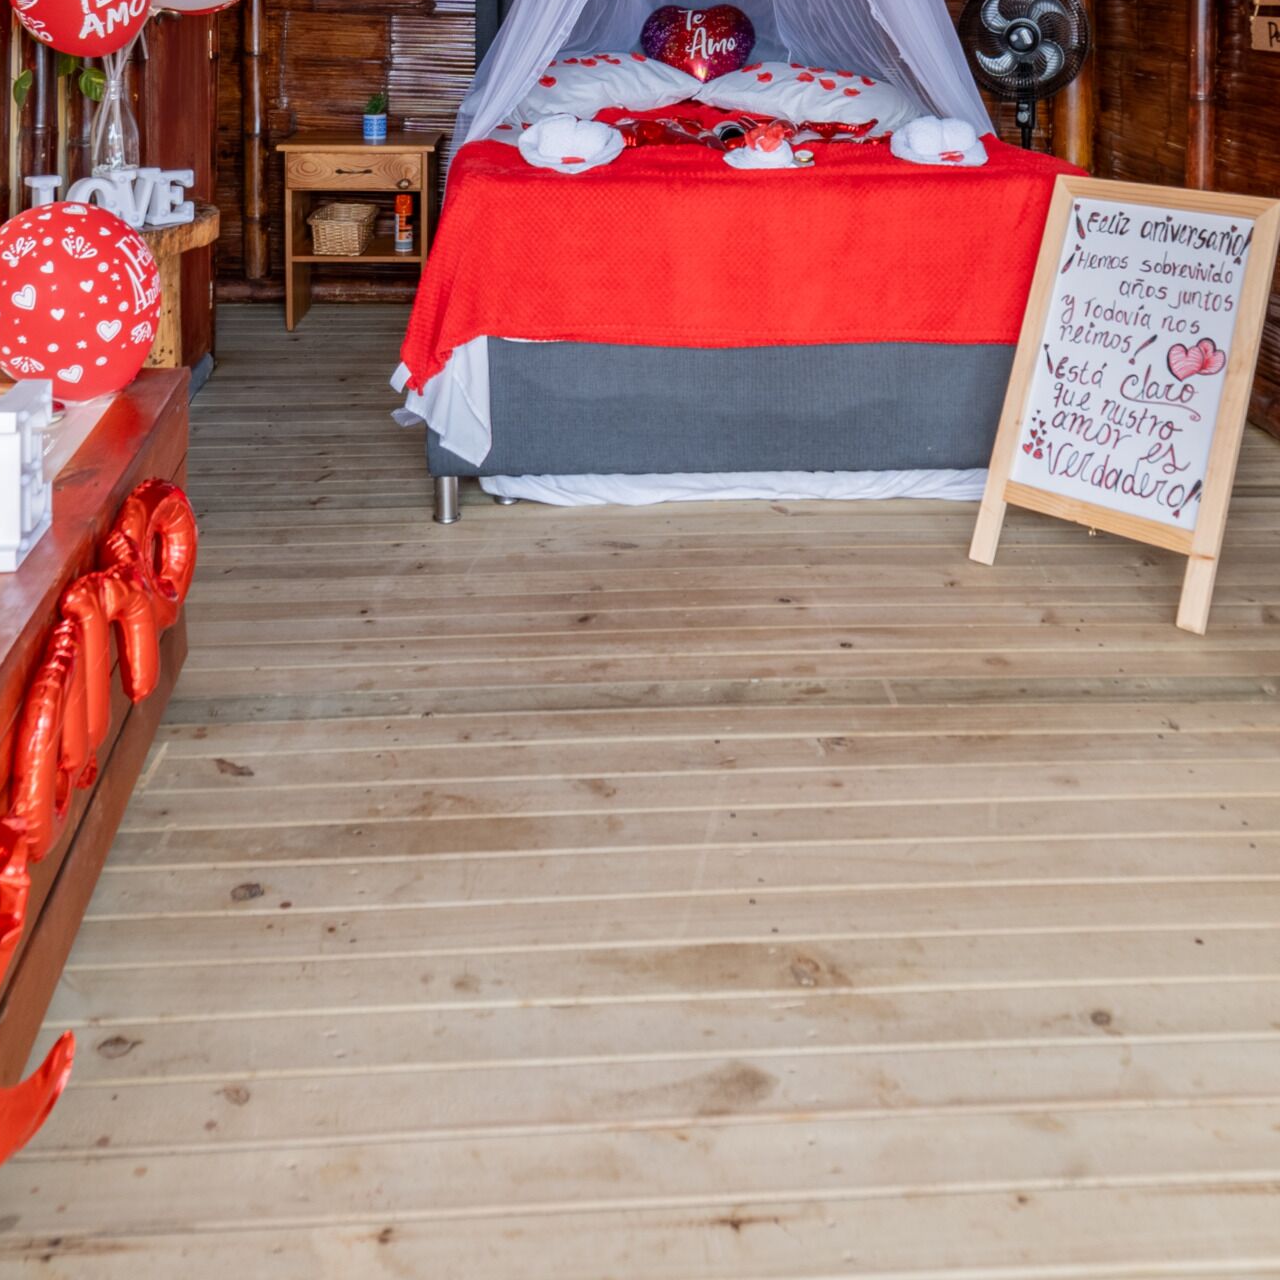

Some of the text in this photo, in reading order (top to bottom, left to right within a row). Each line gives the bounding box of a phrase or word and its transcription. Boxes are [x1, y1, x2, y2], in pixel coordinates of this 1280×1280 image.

[678, 9, 706, 31] Te
[685, 26, 737, 60] Amo
[1139, 251, 1233, 284] sobrevivido
[1119, 278, 1234, 313] años juntos
[1060, 294, 1075, 325] y
[1161, 314, 1200, 335] nos
[1053, 381, 1091, 412] que
[1051, 410, 1191, 475] amor es
